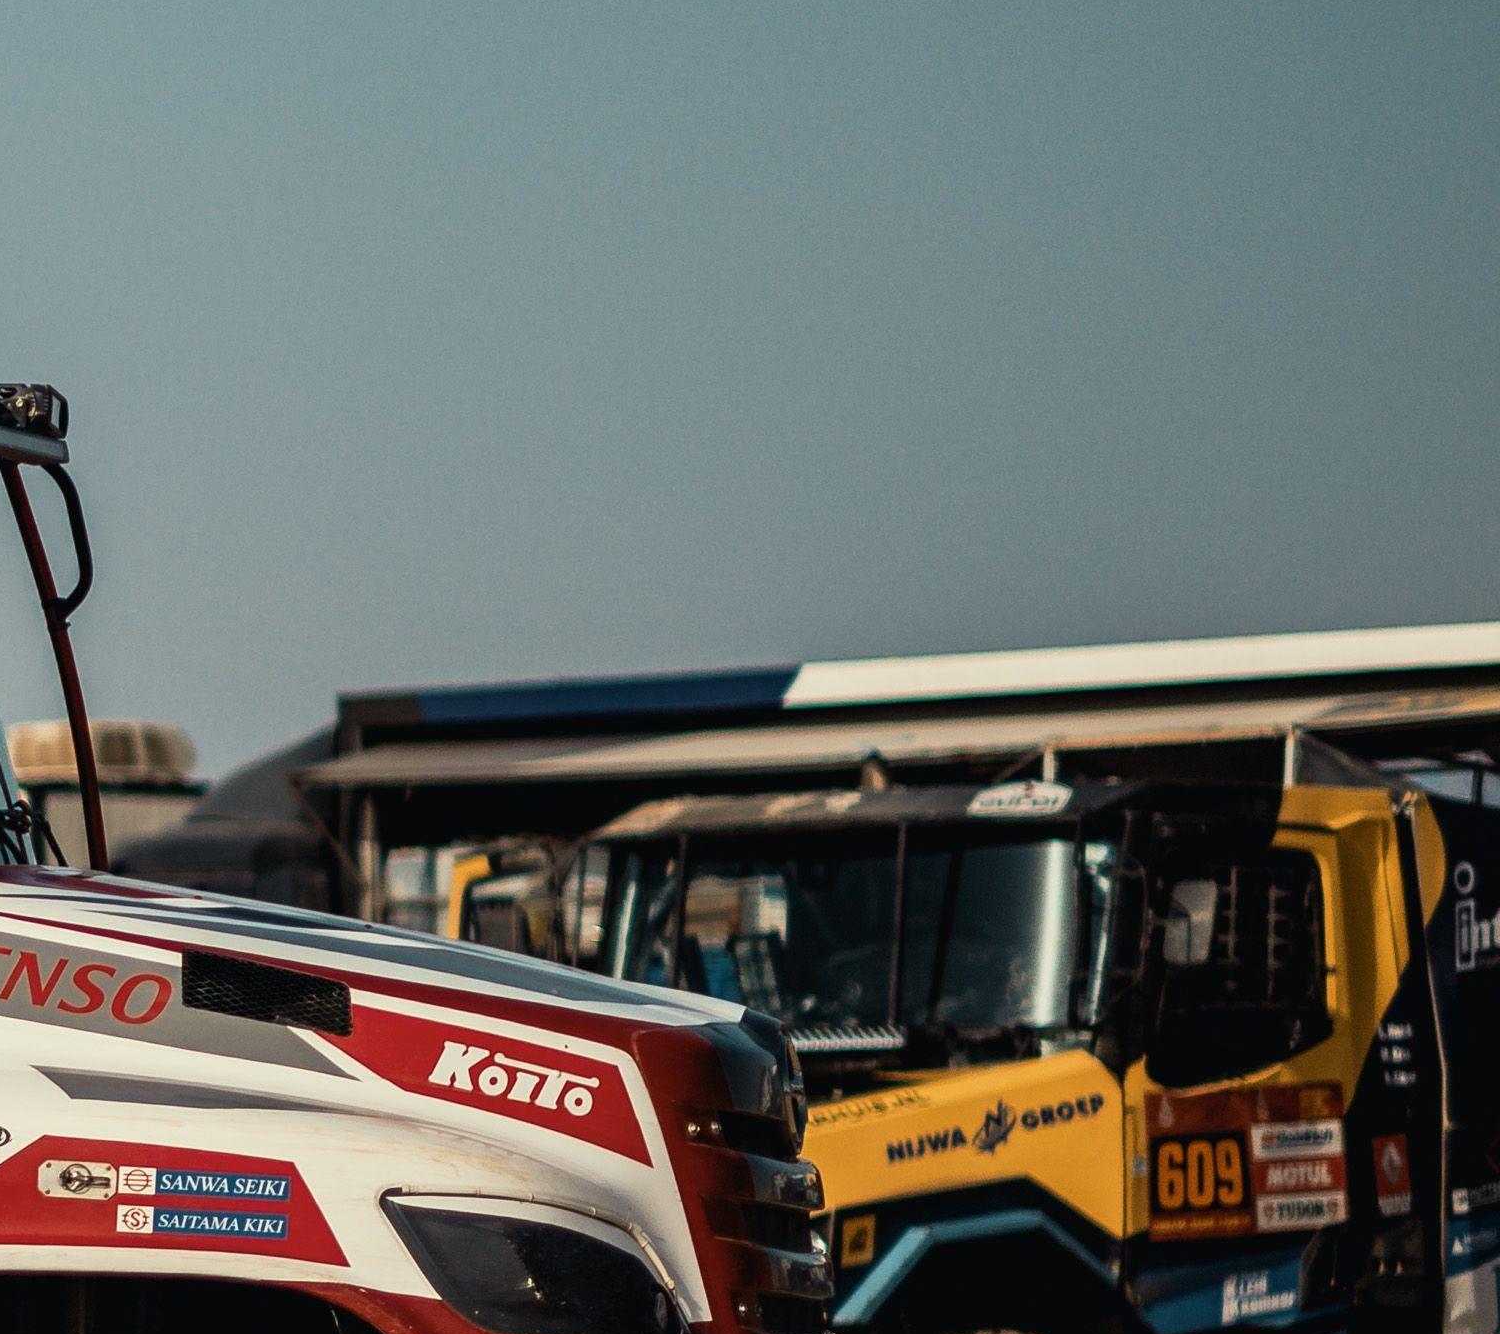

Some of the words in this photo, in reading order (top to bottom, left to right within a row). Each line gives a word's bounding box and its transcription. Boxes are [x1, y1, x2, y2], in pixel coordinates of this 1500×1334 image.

[886, 1125, 968, 1165] NIJWA
[1020, 1092, 1105, 1132] GROEP
[159, 1173, 230, 1194] SANWA
[233, 1178, 288, 1197] SEIKI
[1157, 1137, 1245, 1211] 609
[157, 1213, 240, 1232] SAITAMA
[242, 1218, 284, 1234] KIKI
